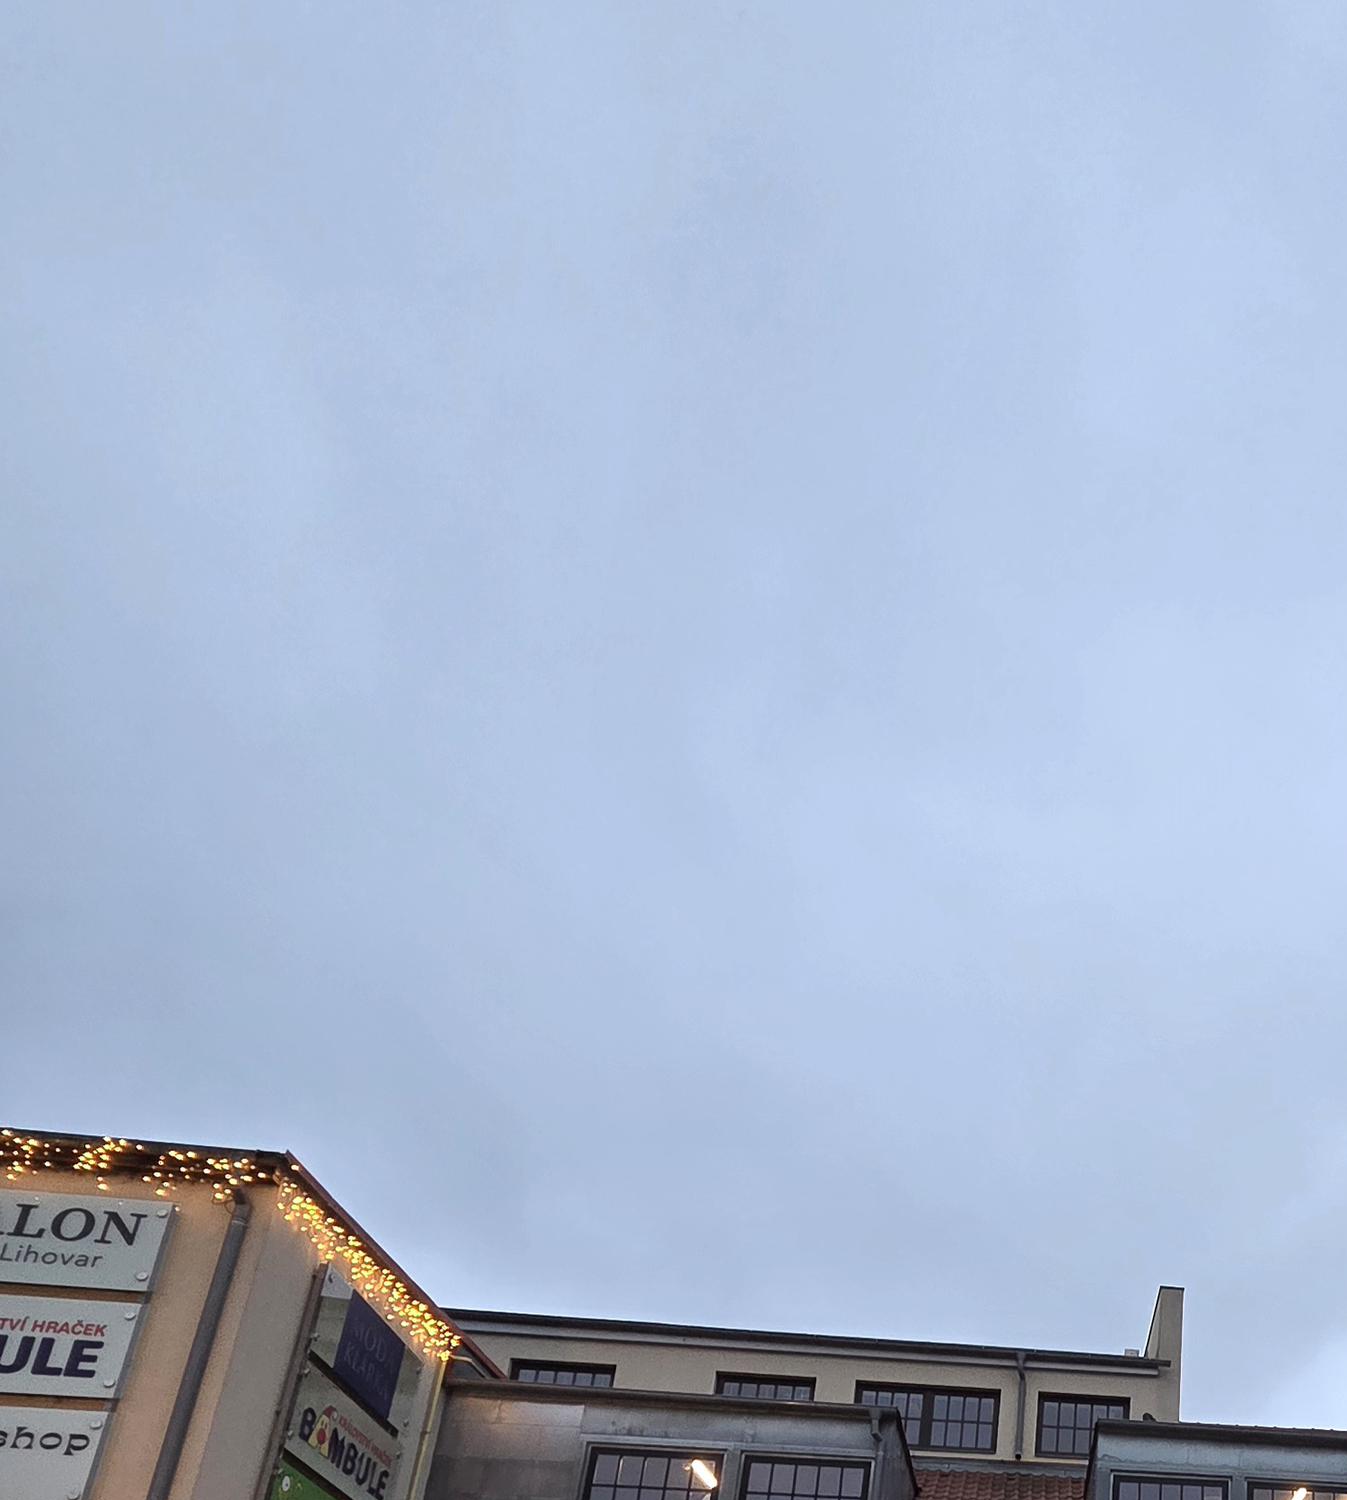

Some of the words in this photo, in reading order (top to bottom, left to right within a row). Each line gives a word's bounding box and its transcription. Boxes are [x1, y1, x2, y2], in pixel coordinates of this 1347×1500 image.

[0, 1204, 147, 1246] LON
[0, 1243, 103, 1268] Lihovar
[31, 1319, 107, 1337] HRAČEK
